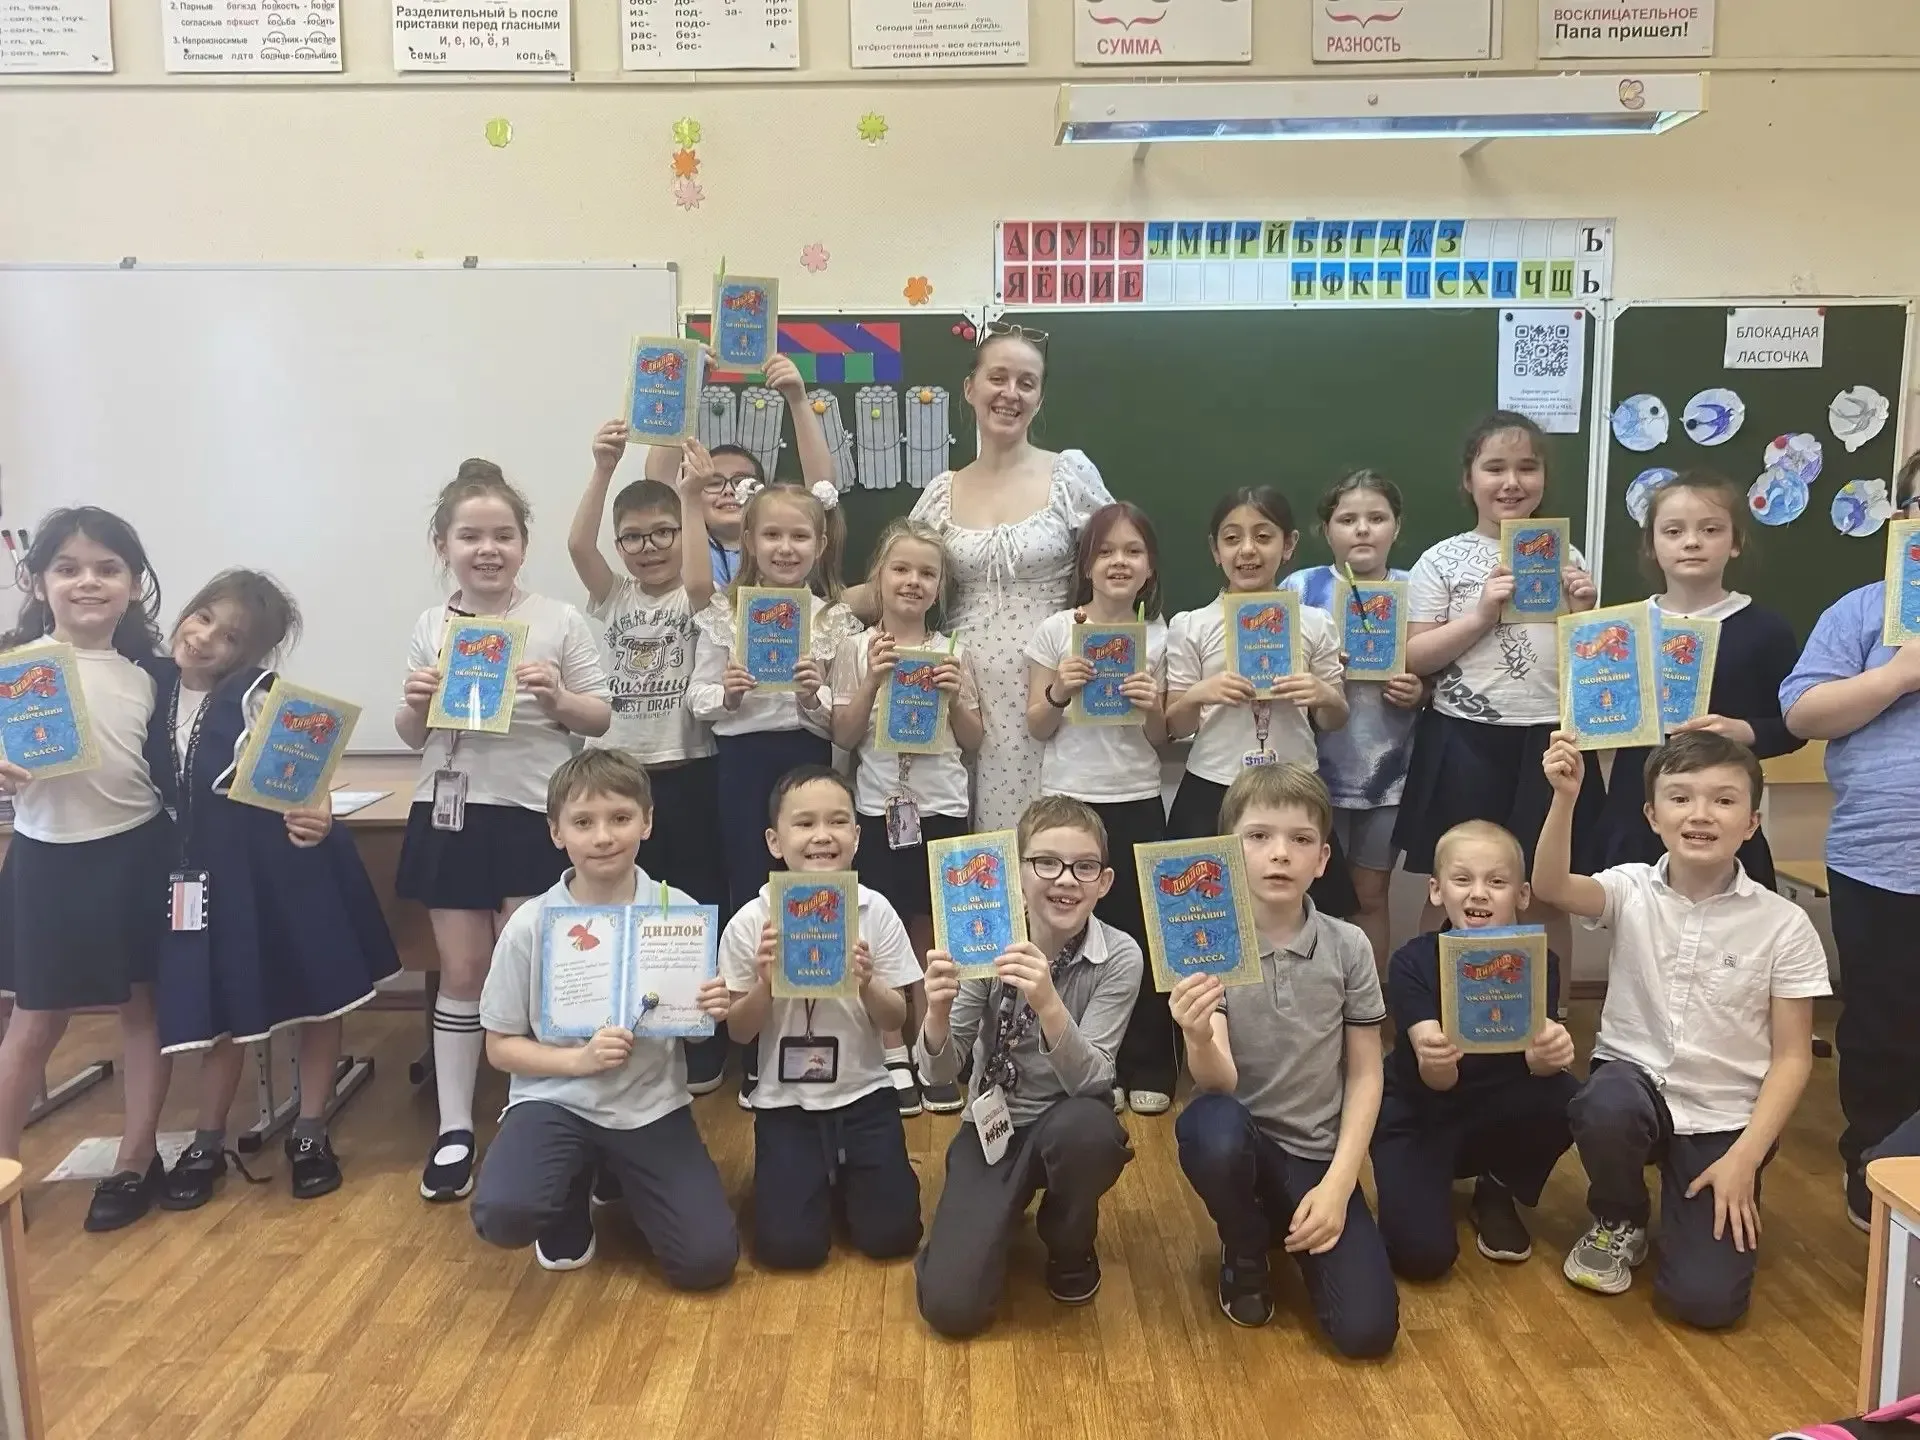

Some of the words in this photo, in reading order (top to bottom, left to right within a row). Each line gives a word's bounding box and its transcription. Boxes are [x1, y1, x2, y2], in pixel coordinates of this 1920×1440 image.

[180, 2, 213, 11] Парные
[765, 7, 792, 16] про-
[396, 6, 505, 18] Разделительный
[521, 10, 558, 18] после
[675, 9, 703, 17] под-
[1554, 7, 1698, 21] ВОСКЛИЦАТЕЛЬНОЕ
[181, 19, 222, 27] согласные
[396, 20, 458, 30] приставки
[462, 20, 498, 31] перед
[501, 21, 560, 30] гласными
[675, 20, 711, 29] подо-
[765, 19, 792, 28] пре-
[875, 24, 913, 32] Сегодня
[935, 22, 969, 30] мелкий
[630, 32, 657, 40] рас-
[675, 30, 702, 39] без-
[1555, 23, 1601, 39] Папа
[1608, 22, 1689, 41] пришел!
[182, 36, 248, 46] Непроизносимые
[502, 36, 510, 46] я
[676, 41, 702, 50] бес-
[967, 40, 1021, 48] остальные
[1327, 36, 1401, 53] РАЗНОСТЬ
[631, 43, 657, 52] раз-
[1096, 38, 1163, 55] СУММА
[183, 52, 224, 61] согласные
[410, 51, 447, 60] семья
[516, 50, 551, 60] копьё
[1007, 229, 1026, 255] А
[1035, 228, 1055, 255] О
[1064, 228, 1084, 255] У
[1092, 228, 1113, 255] Ы
[1122, 228, 1140, 255] Э
[1150, 228, 1169, 255] Л
[1178, 228, 1199, 254] М
[1207, 227, 1227, 254] Н
[1238, 227, 1257, 254] Р
[1267, 222, 1286, 253] Й
[1296, 227, 1314, 254] Б
[1325, 228, 1343, 254] В
[1354, 227, 1374, 253] Г
[1381, 227, 1403, 255] Д
[1409, 227, 1432, 254] Ж
[1440, 227, 1456, 253] З
[1582, 227, 1603, 252] Ъ
[1006, 272, 1024, 298] Я
[1036, 266, 1053, 298] Ё
[1063, 271, 1084, 298] Ю
[1091, 271, 1112, 298] И
[1123, 271, 1140, 298] Е
[1293, 271, 1313, 296] П
[1322, 271, 1343, 296] Ф
[1352, 271, 1371, 296] К
[1381, 270, 1399, 295] Т
[1407, 270, 1429, 296] Ш
[1437, 270, 1457, 295] С
[1465, 270, 1487, 295] Х
[1494, 269, 1514, 297] Ц
[1524, 269, 1542, 294] Ч
[1551, 269, 1573, 296] Щ
[1582, 269, 1600, 294] Ь
[1736, 326, 1819, 339] БЛОКАДНАЯ
[1736, 350, 1810, 363] ЛАСТОЧКА
[643, 418, 672, 427] КЛАССА
[1579, 674, 1631, 685] ОКОНЧАНИИ
[607, 676, 690, 696] Rushing
[647, 697, 682, 712] DRAFT
[1589, 714, 1627, 724] КЛАССА
[23, 745, 65, 759] КЛАССА
[1172, 863, 1208, 894] ДИПЛОМ
[951, 901, 1001, 913] ОКОНЧАНИИ
[1168, 910, 1226, 923] ОКОНЧАНИИ
[642, 925, 703, 939] ДИПЛОМ
[962, 944, 998, 953] КЛАССА
[1183, 954, 1226, 966] КЛАССА
[797, 968, 832, 977] КЛАССА
